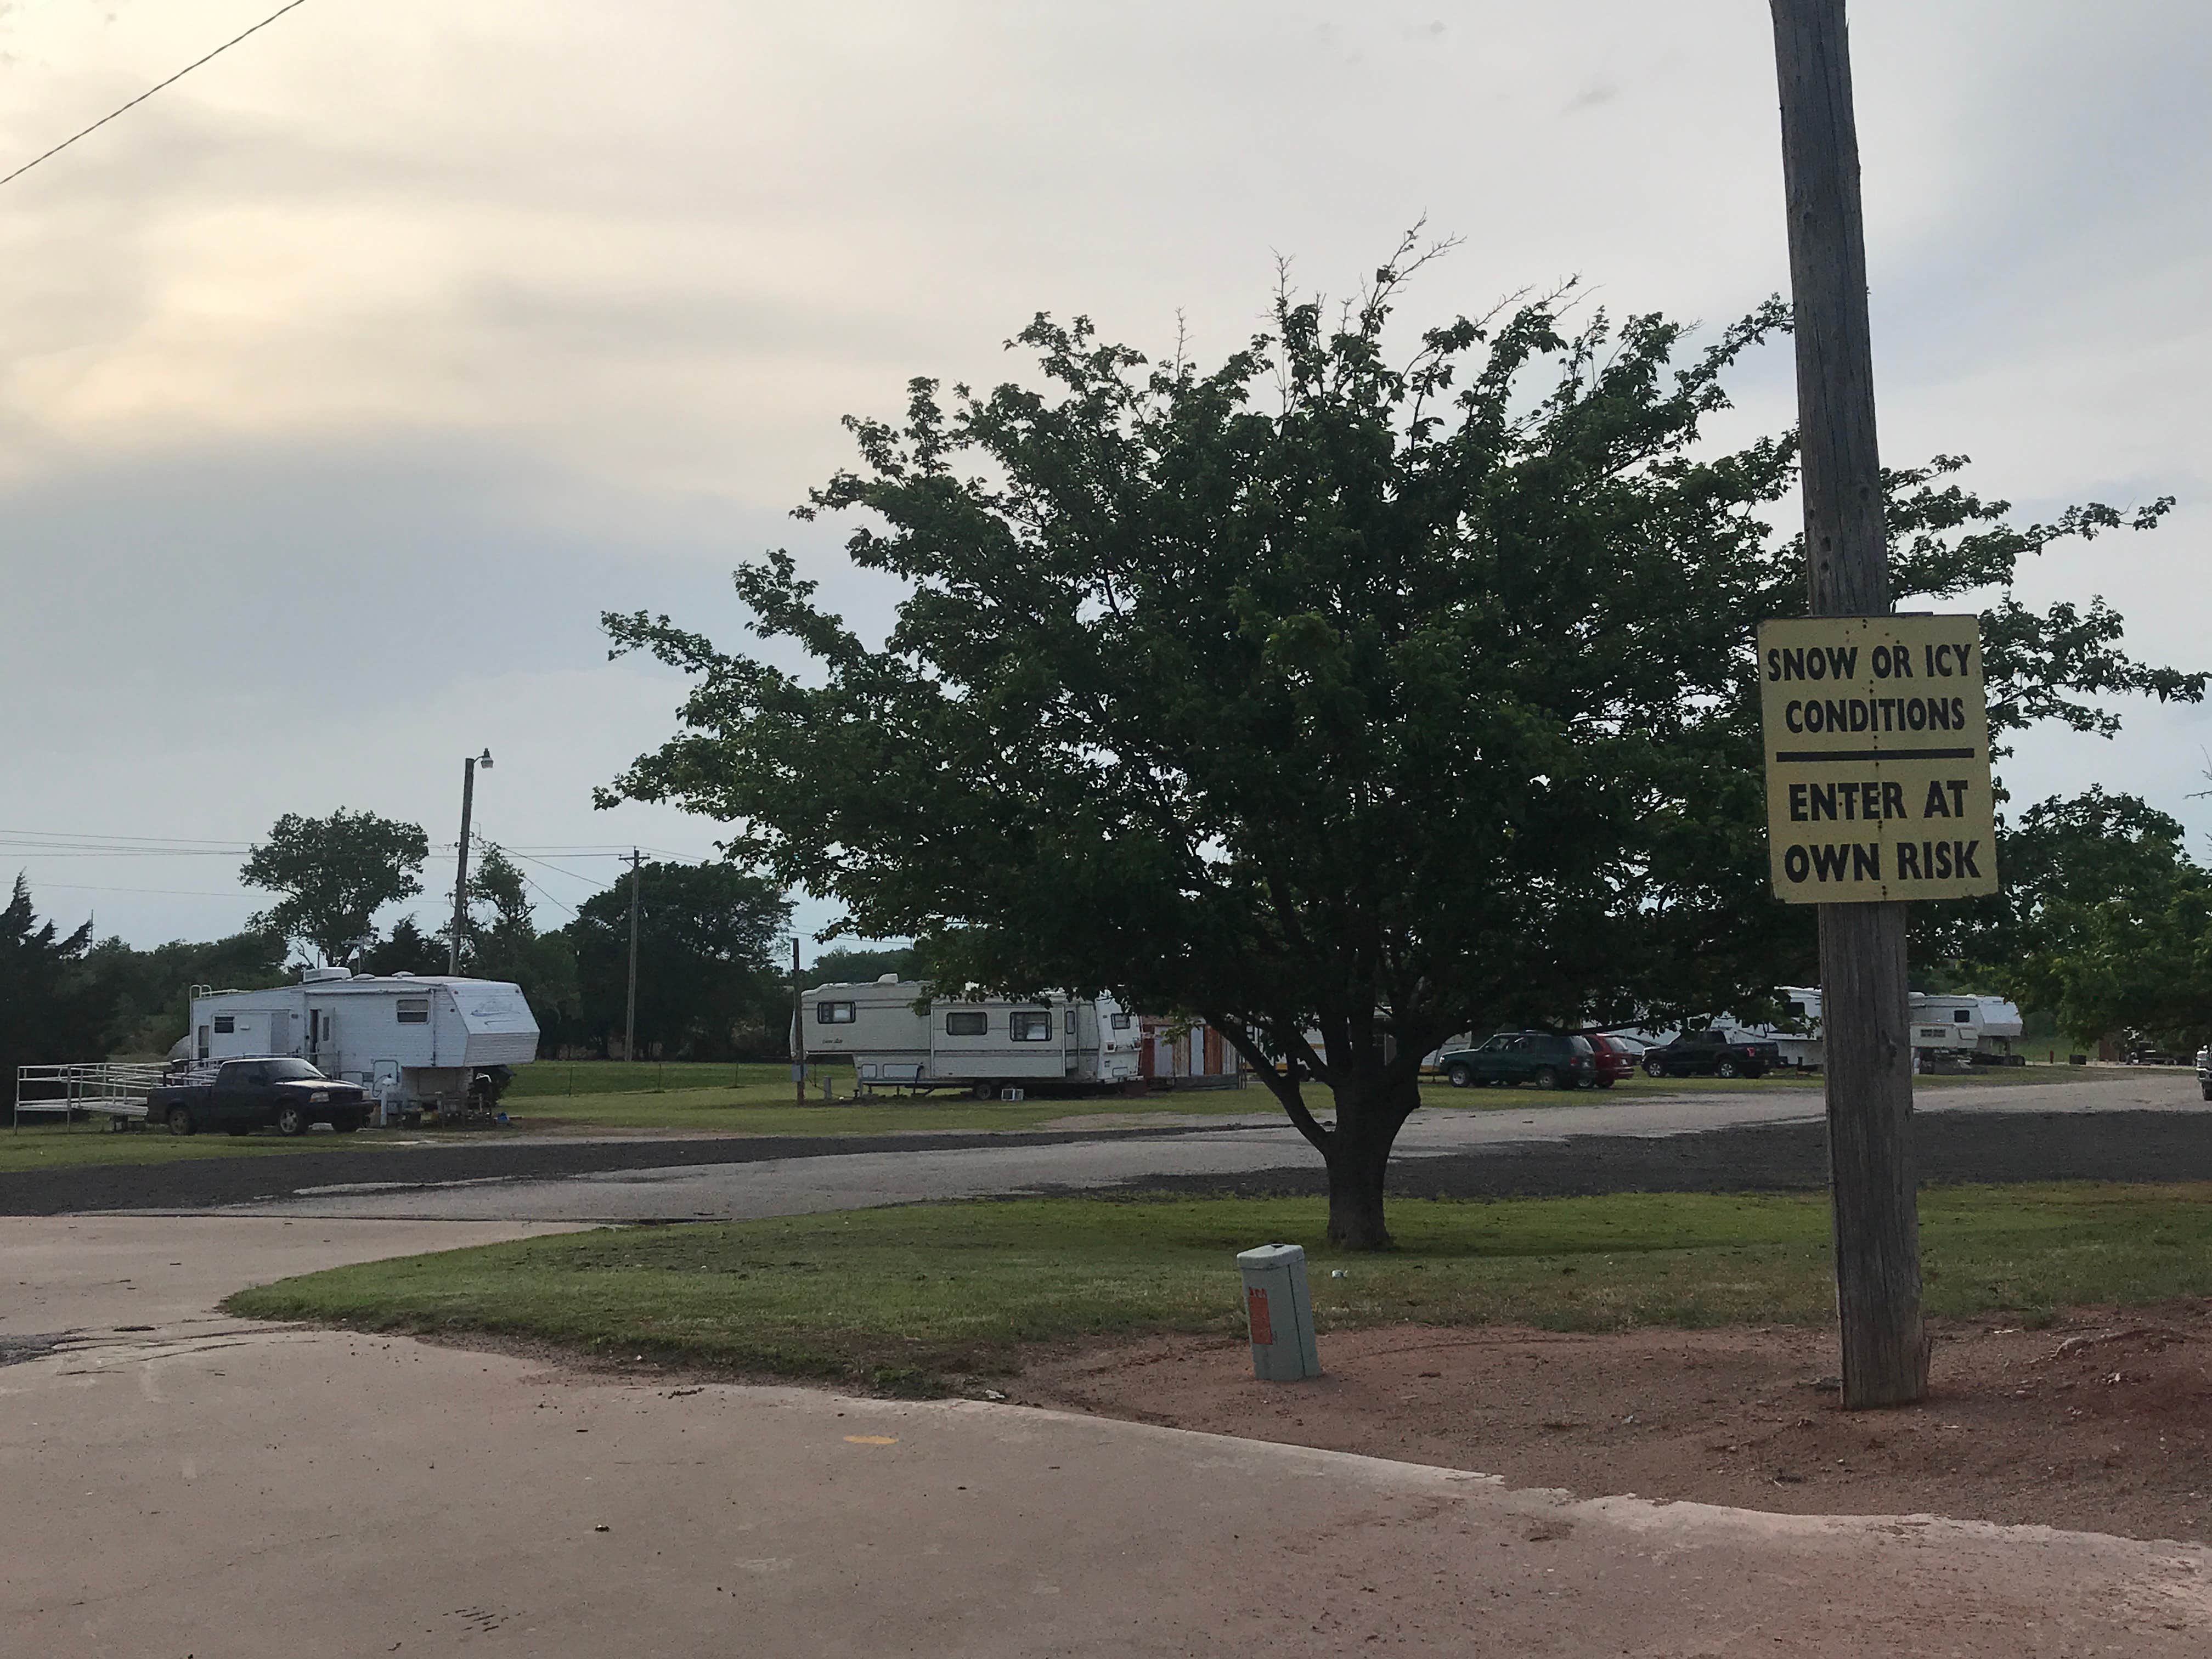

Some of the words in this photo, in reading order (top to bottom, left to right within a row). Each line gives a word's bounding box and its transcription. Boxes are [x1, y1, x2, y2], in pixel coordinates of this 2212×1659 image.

[1768, 646, 1858, 681] SNOW
[1871, 645, 1913, 679] OR
[1925, 644, 1972, 677] ICY
[1785, 697, 1965, 733] CONDITIONS
[1789, 781, 1907, 821] ENTER
[1923, 780, 1968, 819] AT
[1785, 843, 1881, 883] OWN
[1897, 840, 1982, 880] RISK
